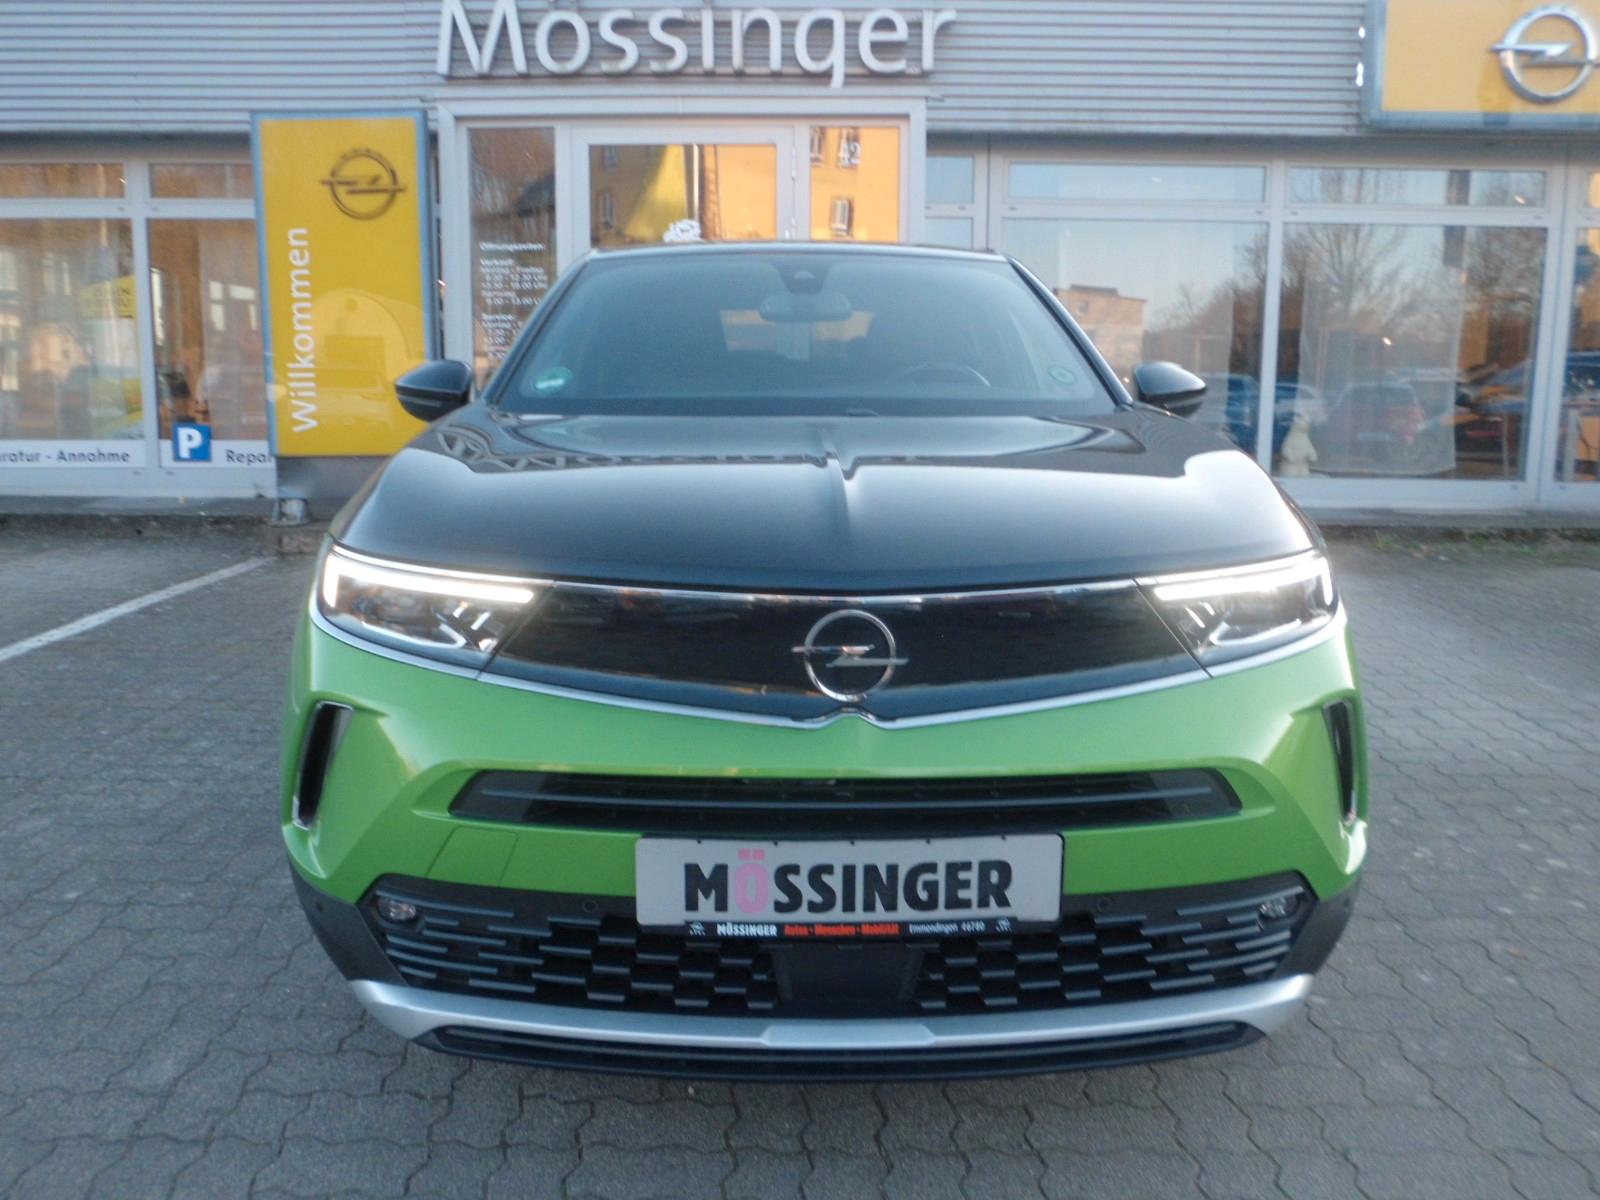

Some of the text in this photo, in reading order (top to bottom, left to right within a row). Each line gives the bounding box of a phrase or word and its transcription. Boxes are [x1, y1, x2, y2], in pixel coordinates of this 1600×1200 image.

[287, 227, 318, 433] Willkommen
[57, 448, 130, 462] Annahme
[177, 427, 203, 459] P
[684, 848, 1012, 914] MÖSSINGER
[716, 922, 778, 937] MÖSSINGER
